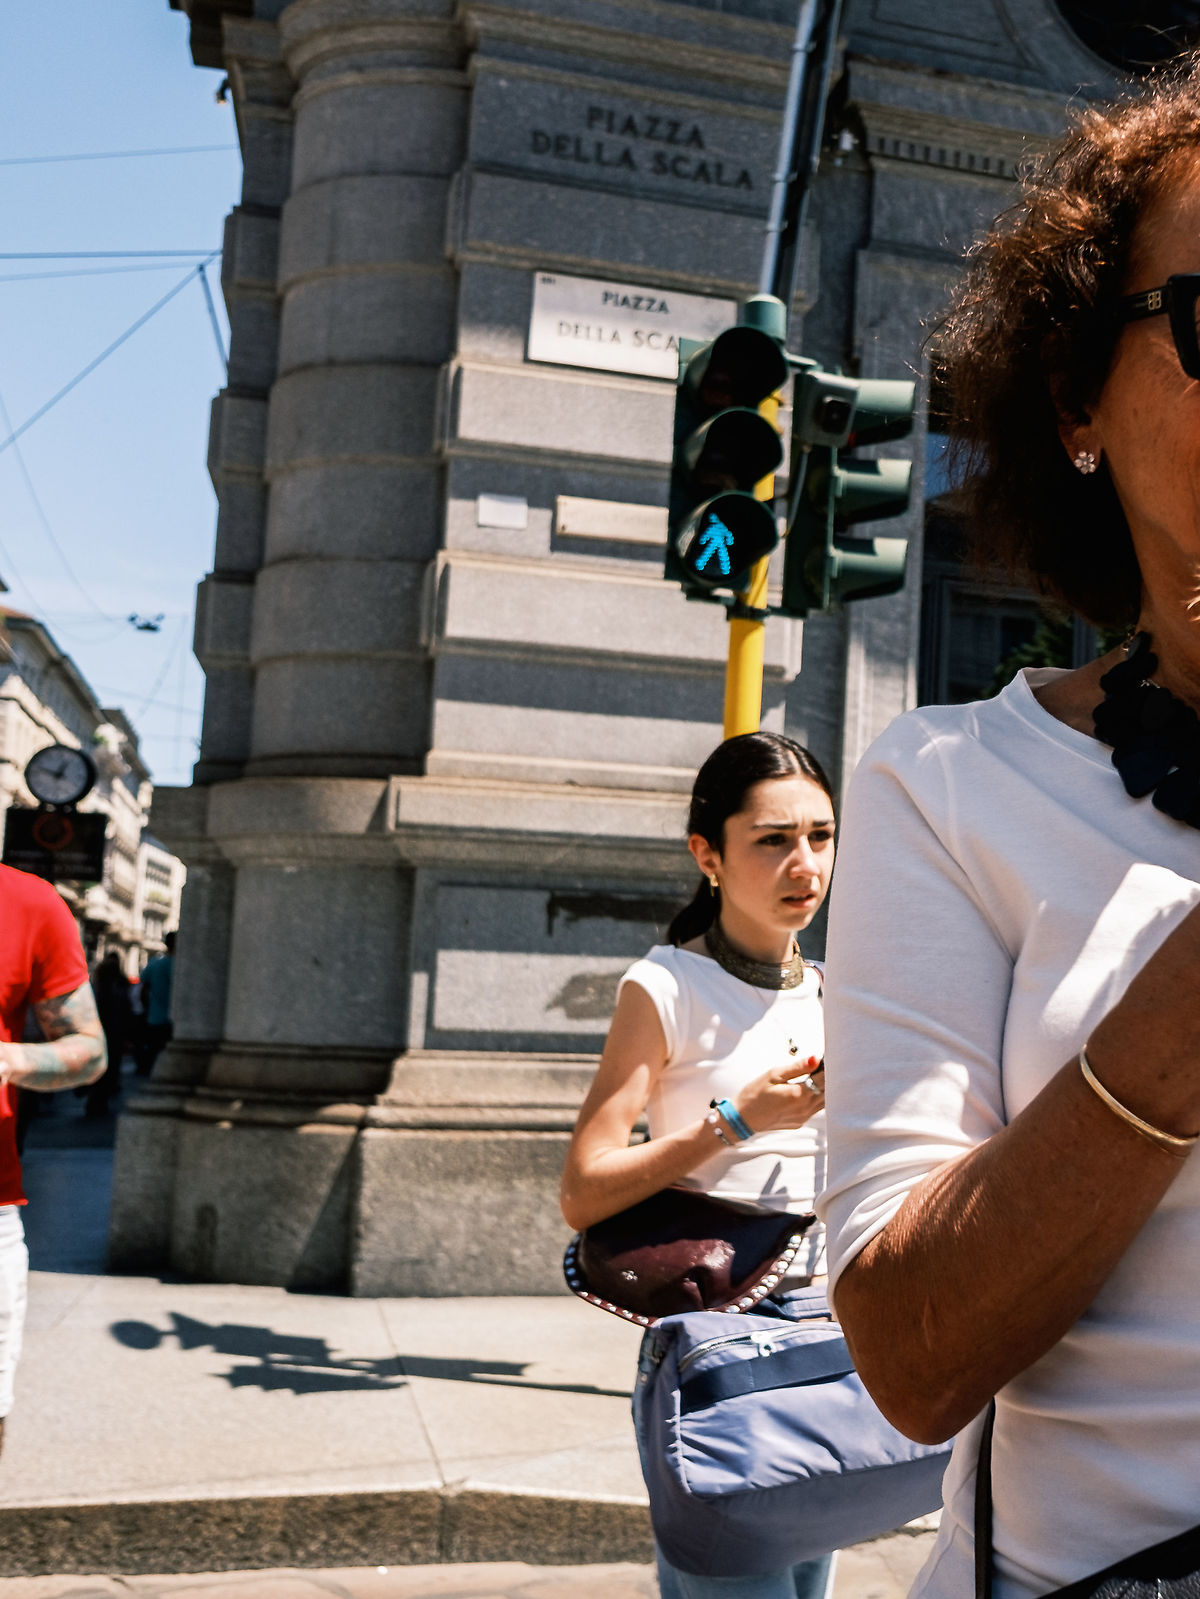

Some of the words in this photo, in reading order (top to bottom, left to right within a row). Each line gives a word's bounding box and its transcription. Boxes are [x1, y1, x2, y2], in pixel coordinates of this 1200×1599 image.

[586, 105, 705, 149] PIAZZA
[531, 129, 637, 171] DELLA
[651, 151, 753, 190] SCALA
[602, 290, 670, 314] PIAZZA
[558, 320, 622, 343] DELLA
[633, 329, 680, 351] SCA
